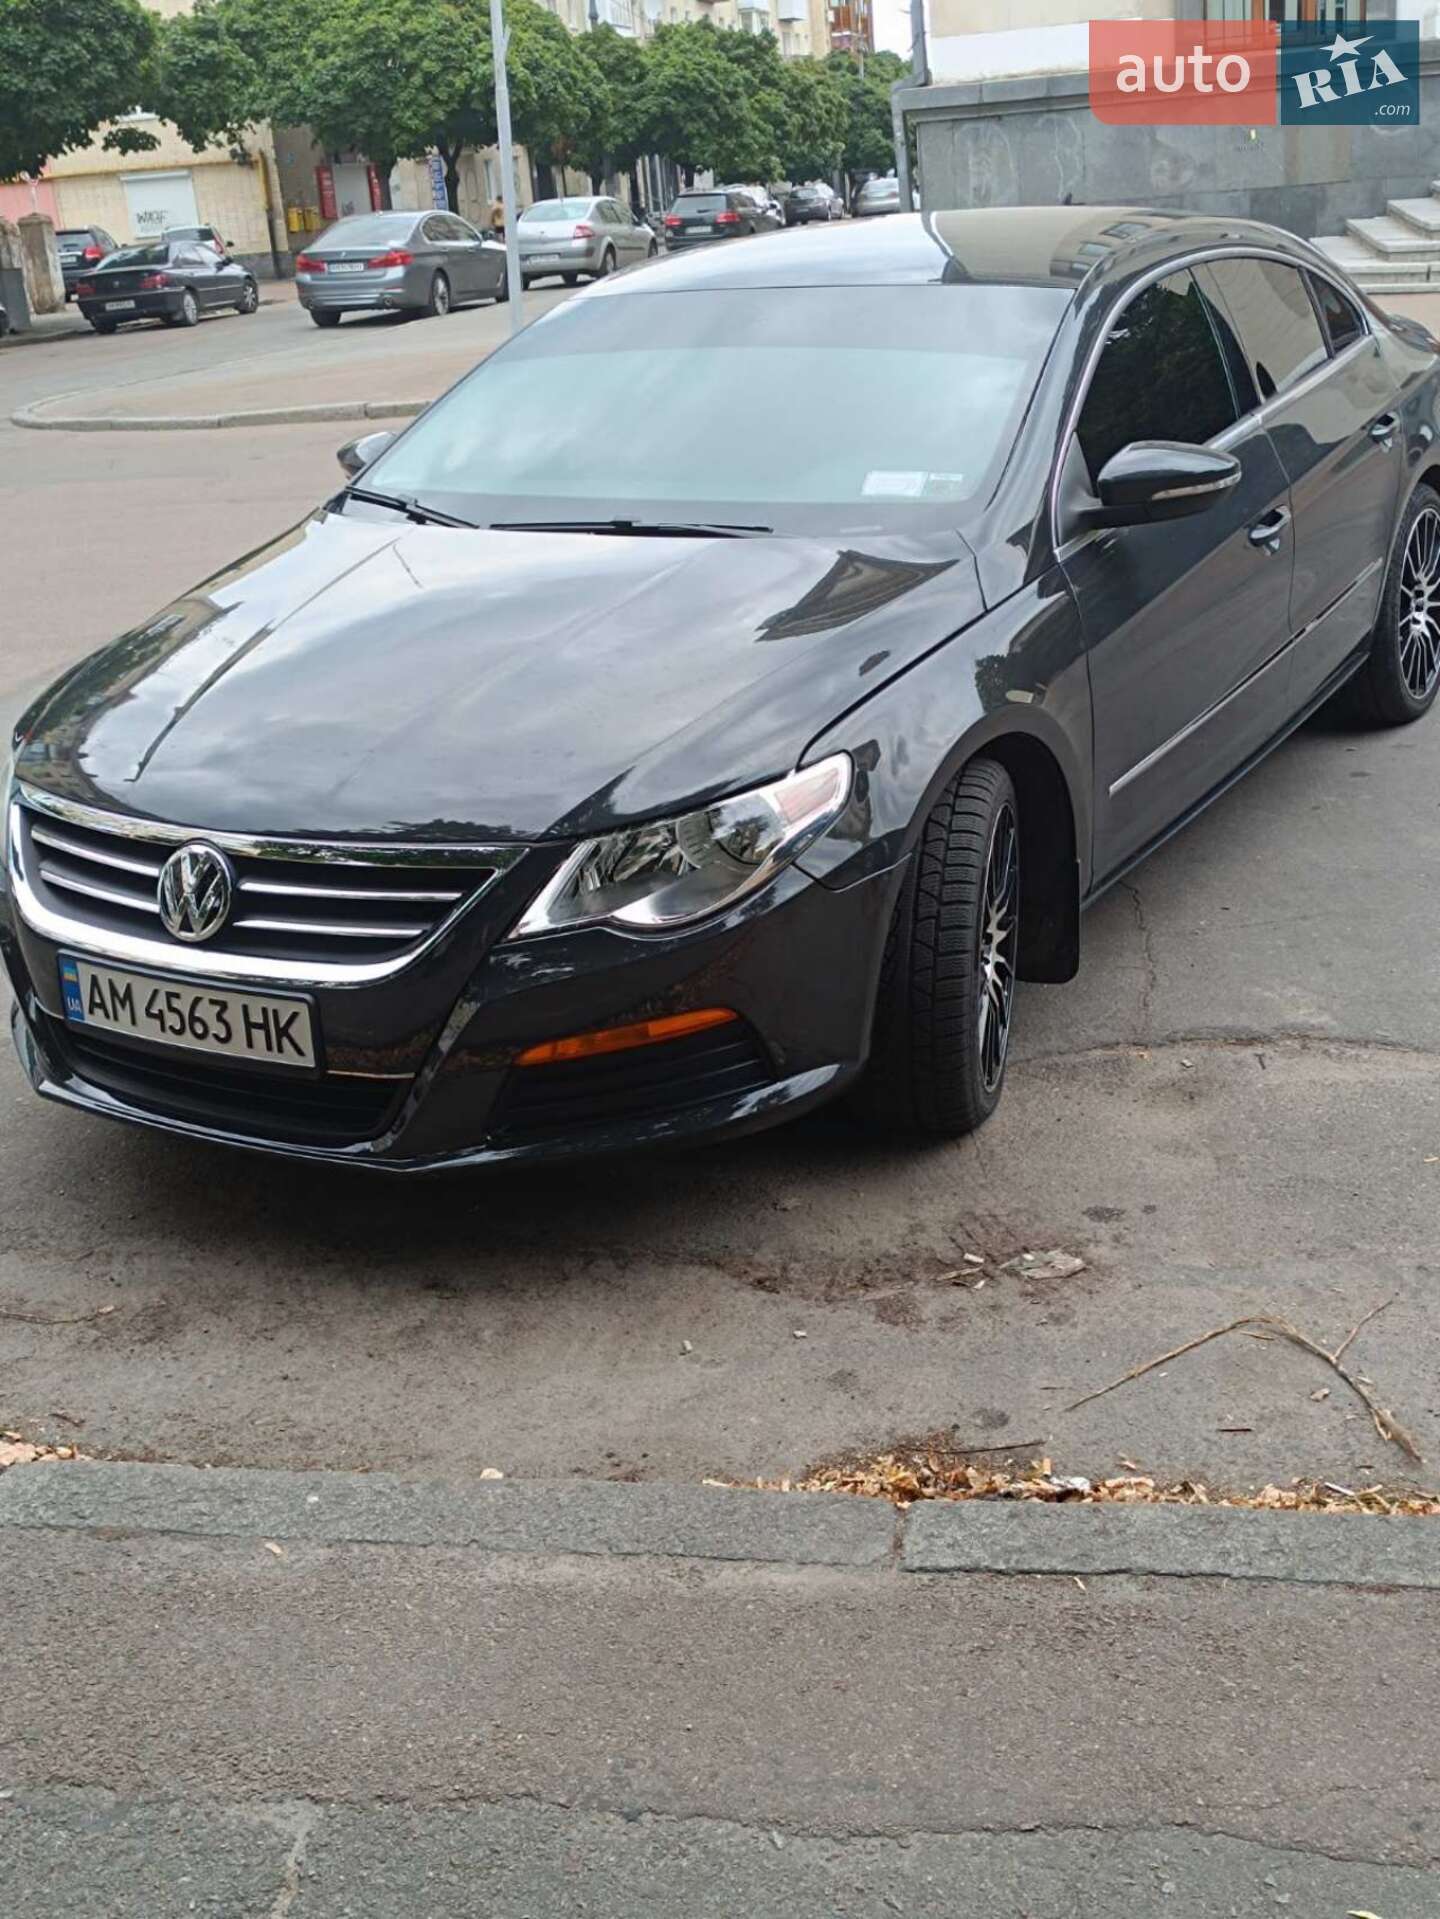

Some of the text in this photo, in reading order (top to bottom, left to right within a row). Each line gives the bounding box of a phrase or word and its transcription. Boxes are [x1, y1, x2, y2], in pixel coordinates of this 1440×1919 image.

[67, 999, 83, 1012] UA
[88, 973, 305, 1057] AM 4563 HK
